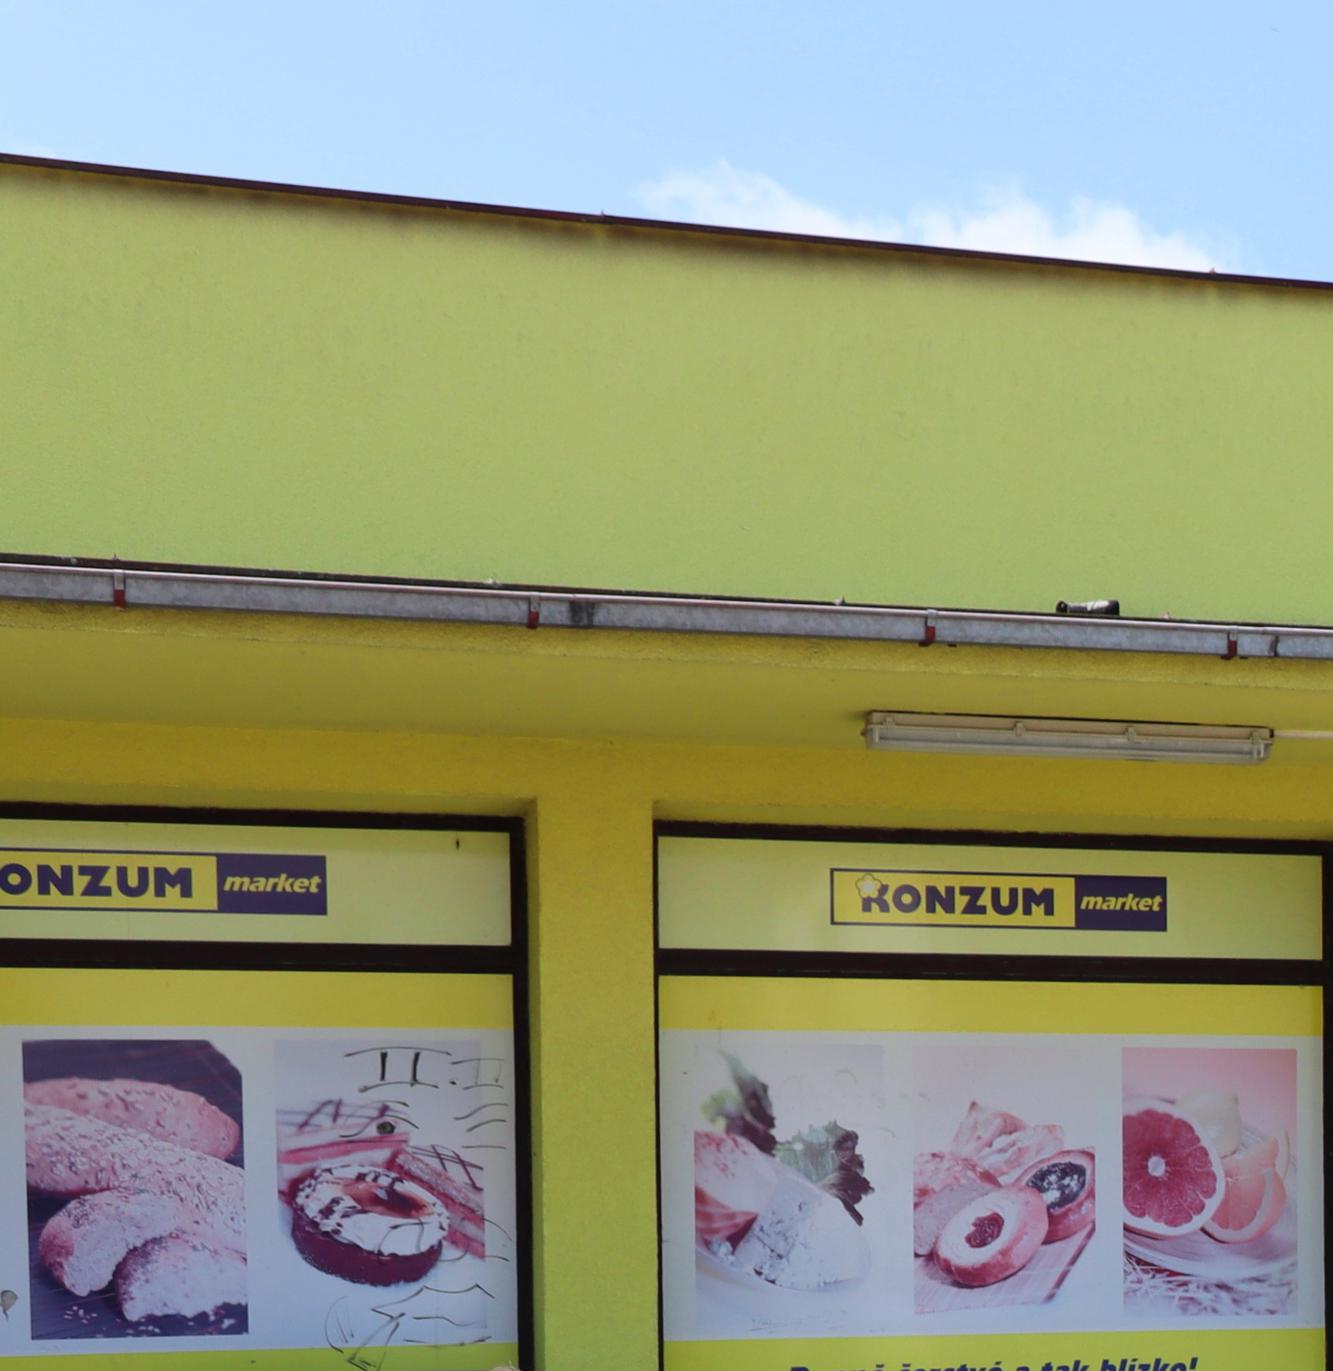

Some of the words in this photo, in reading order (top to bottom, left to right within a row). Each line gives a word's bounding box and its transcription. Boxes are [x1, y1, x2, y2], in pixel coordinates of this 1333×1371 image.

[223, 873, 322, 894] market
[861, 883, 1055, 917] KONZUM
[1080, 893, 1162, 912] market
